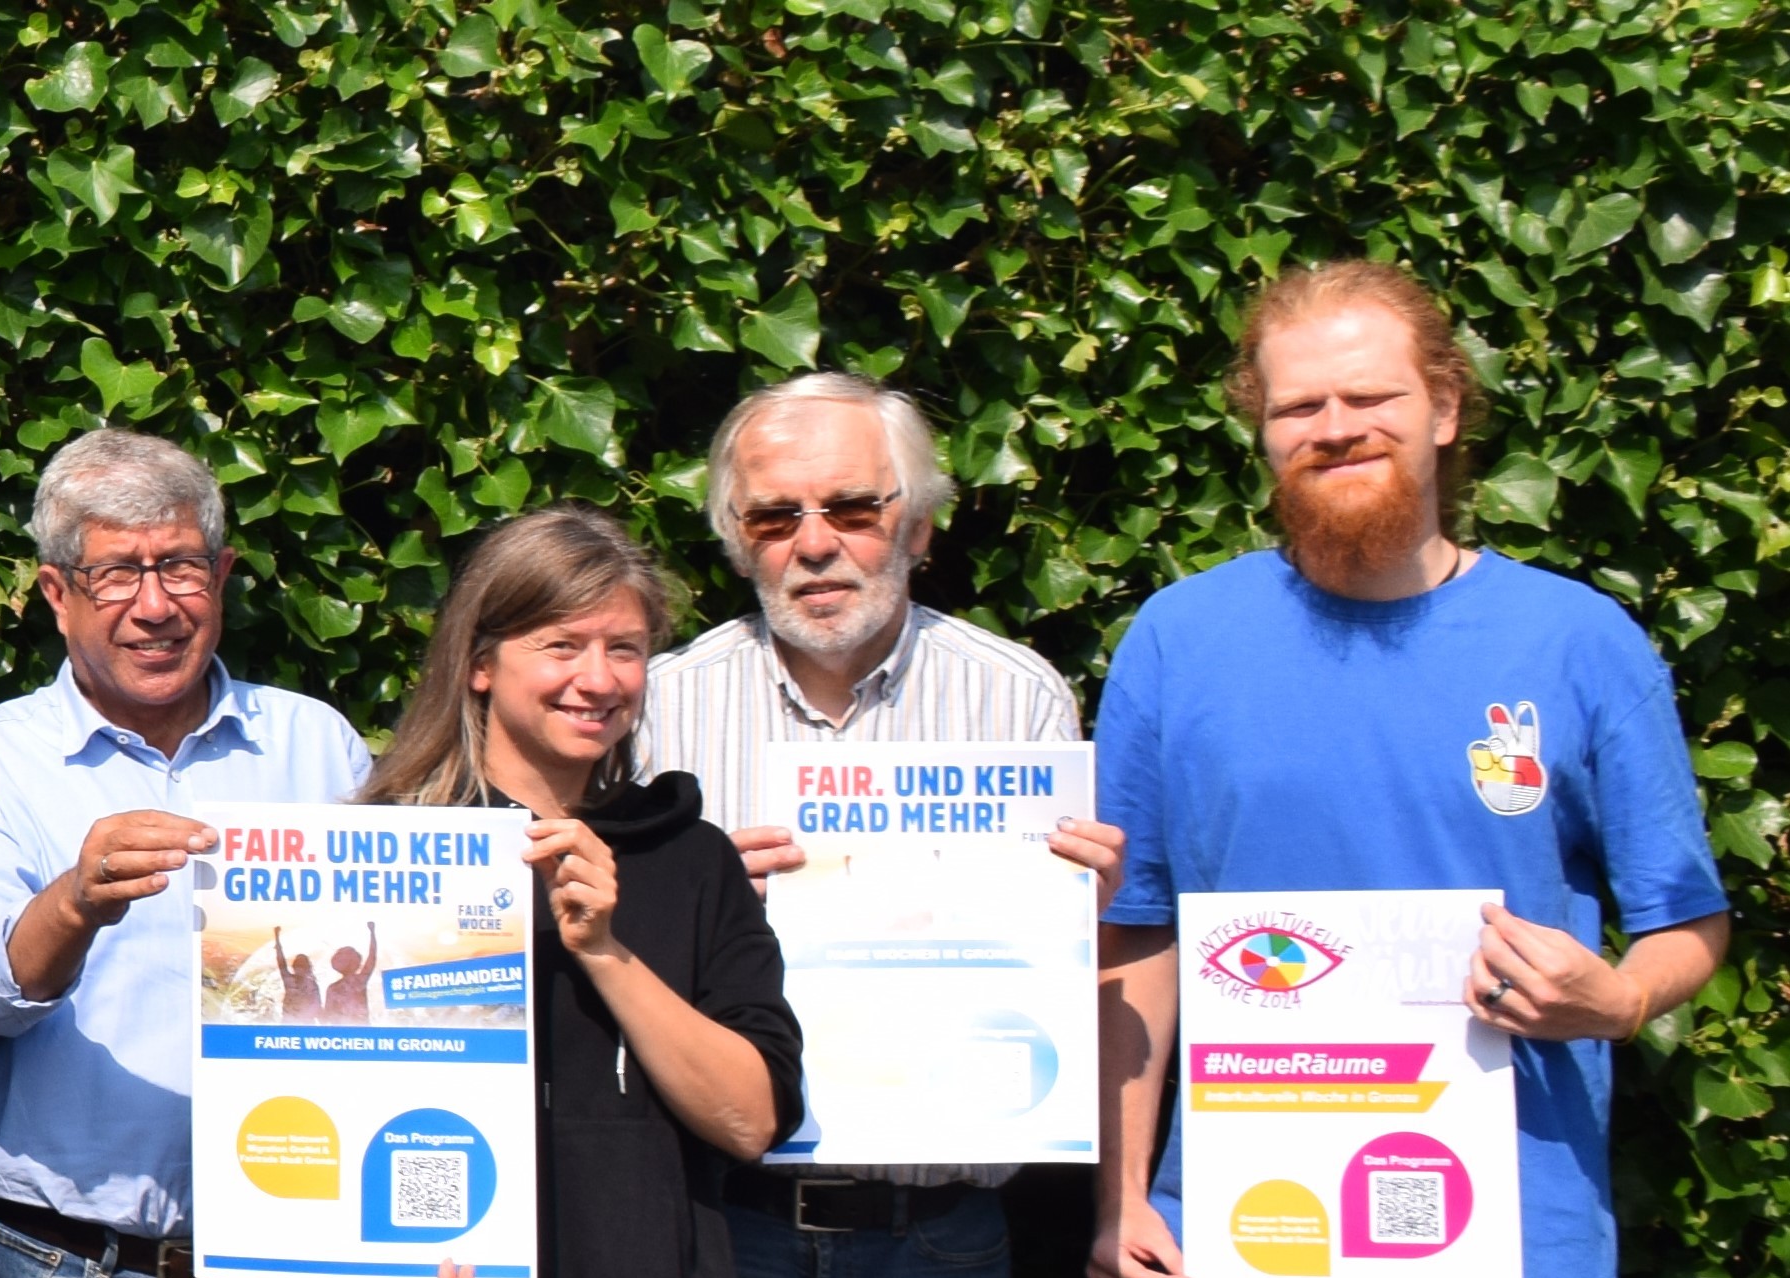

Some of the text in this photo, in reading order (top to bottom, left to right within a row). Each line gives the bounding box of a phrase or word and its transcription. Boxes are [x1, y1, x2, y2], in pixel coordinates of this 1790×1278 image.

[797, 765, 1053, 797] FAIR. UND KEIN
[797, 802, 1006, 833] GRAD MEHR!
[224, 828, 489, 866] FAIR. UND KEIN
[223, 867, 441, 904] GRAD MEHR!
[458, 905, 493, 916] FAIRE
[458, 918, 502, 930] WOCHE
[391, 967, 522, 990] #FAIRHANDELN
[1198, 965, 1302, 1009] WOCHE 2024
[254, 1037, 465, 1052] FAIRE WOCHEN IN GRONAU
[1204, 1052, 1387, 1075] #NeueRäume
[384, 1132, 474, 1146] Das Programm
